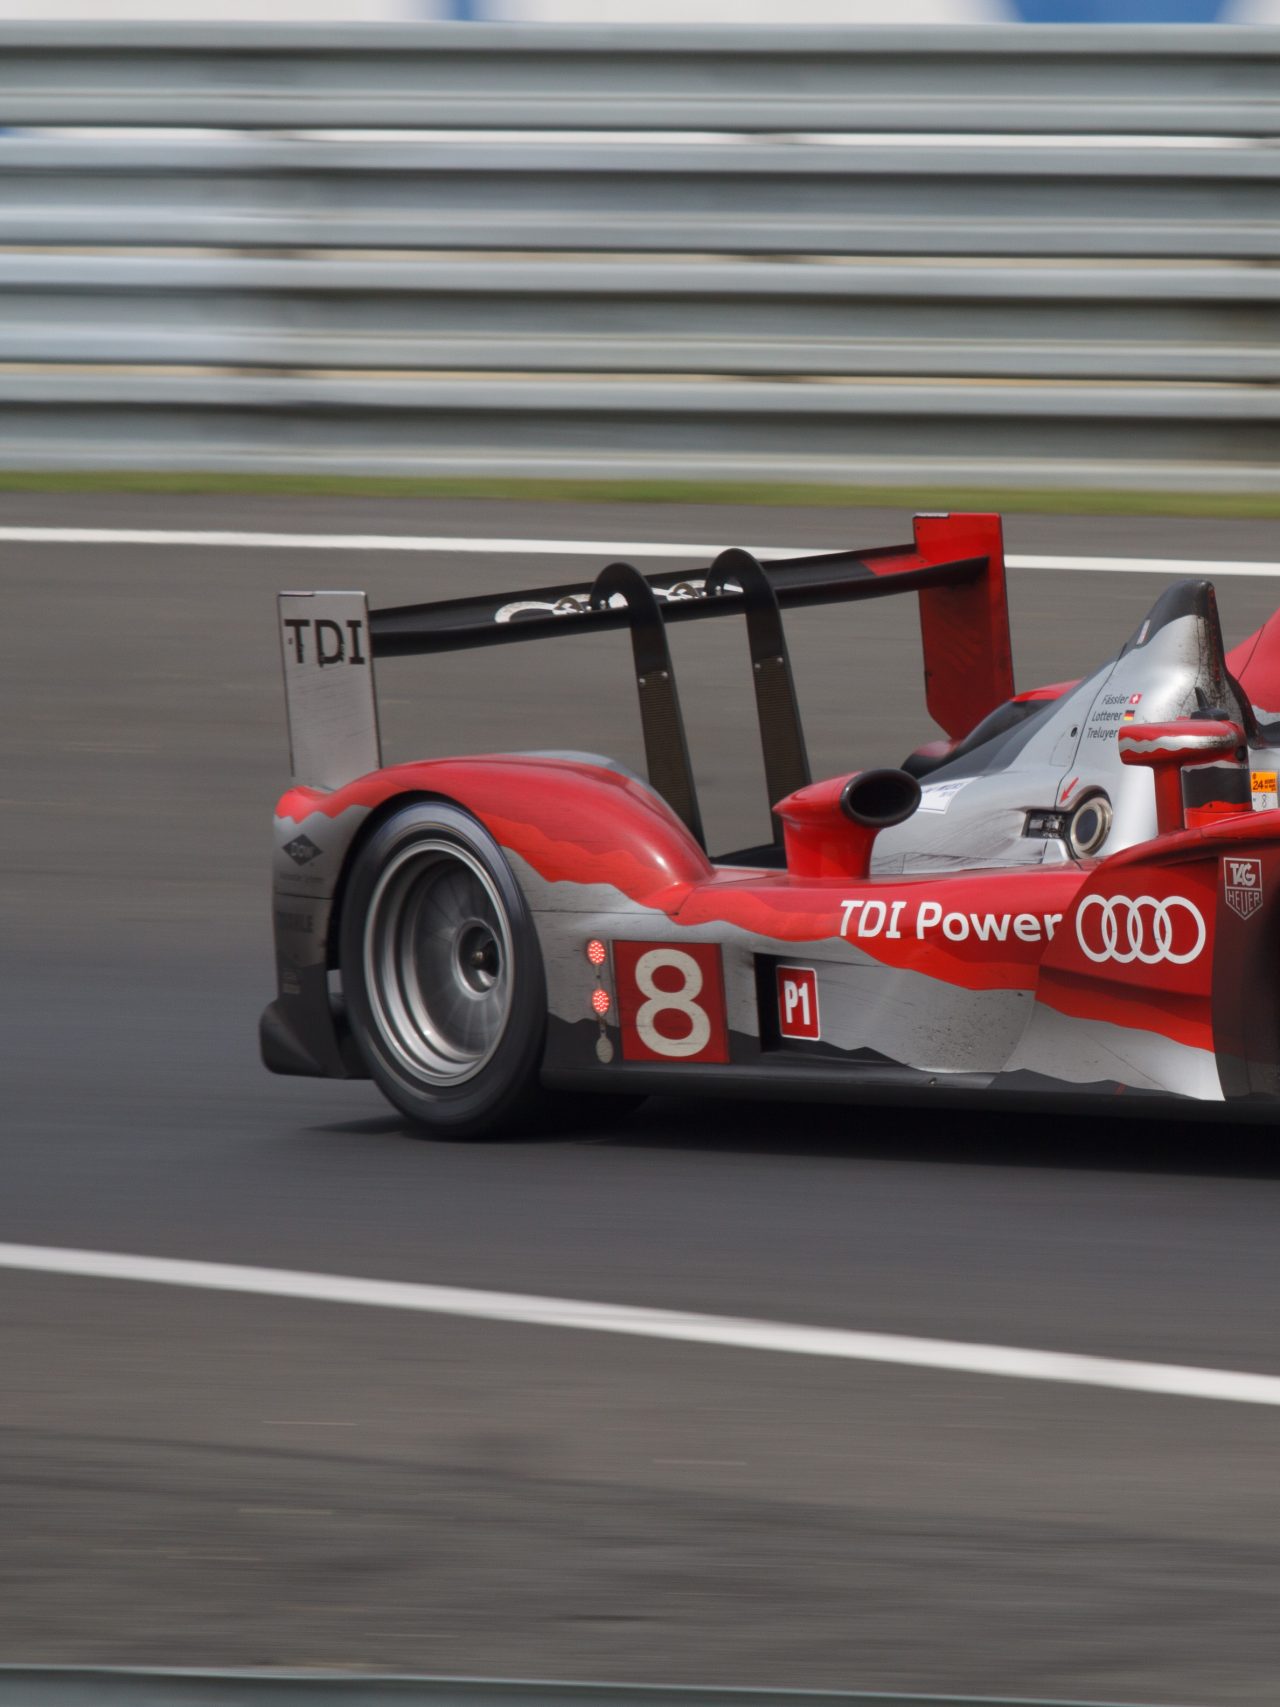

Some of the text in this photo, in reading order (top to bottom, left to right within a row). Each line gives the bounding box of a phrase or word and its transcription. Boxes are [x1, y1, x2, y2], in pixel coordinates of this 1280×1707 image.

[284, 618, 366, 666] TDI
[1091, 711, 1123, 722] Lotterer
[1229, 863, 1256, 886] TAG
[840, 900, 1064, 942] TDI Power
[1228, 890, 1261, 915] HEUER
[635, 948, 711, 1058] 8
[783, 980, 811, 1025] P1
